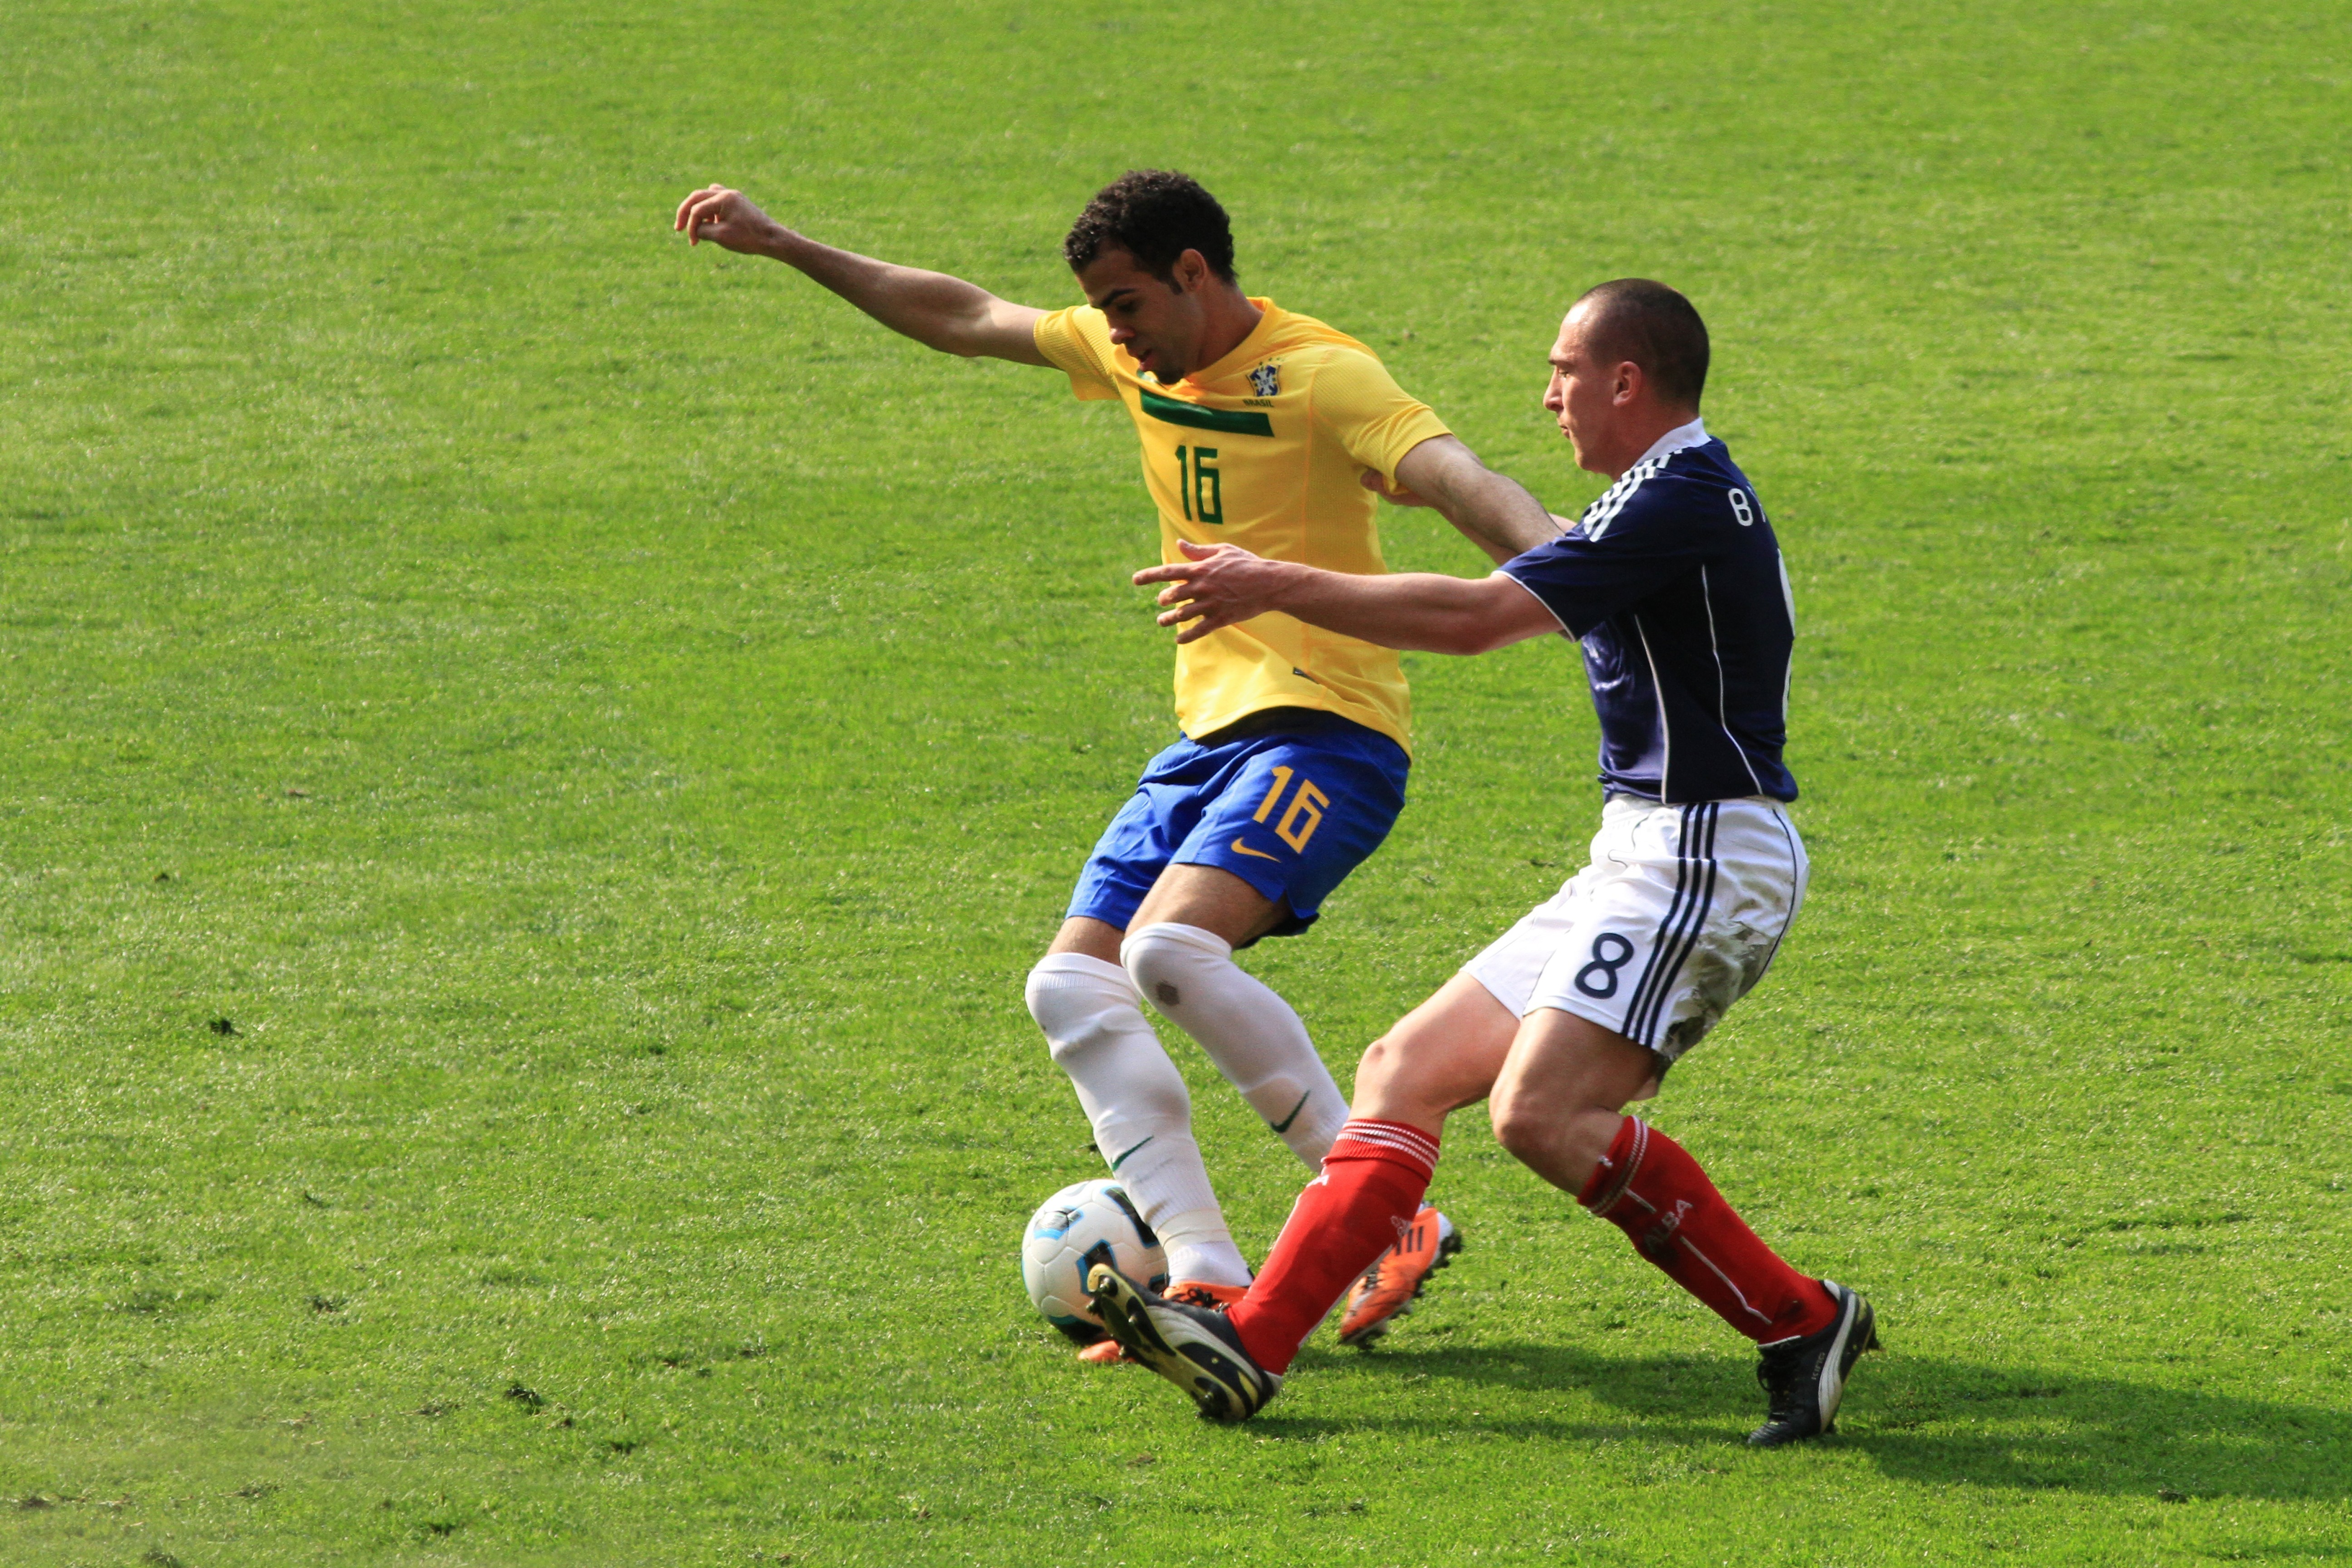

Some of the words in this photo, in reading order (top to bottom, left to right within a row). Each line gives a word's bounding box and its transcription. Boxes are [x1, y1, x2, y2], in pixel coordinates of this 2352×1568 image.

[1243, 399, 1274, 407] BRASIL
[1175, 445, 1223, 524] 16
[1728, 488, 1754, 526] 8
[1253, 765, 1330, 854] 16
[1575, 933, 1634, 999] 8
